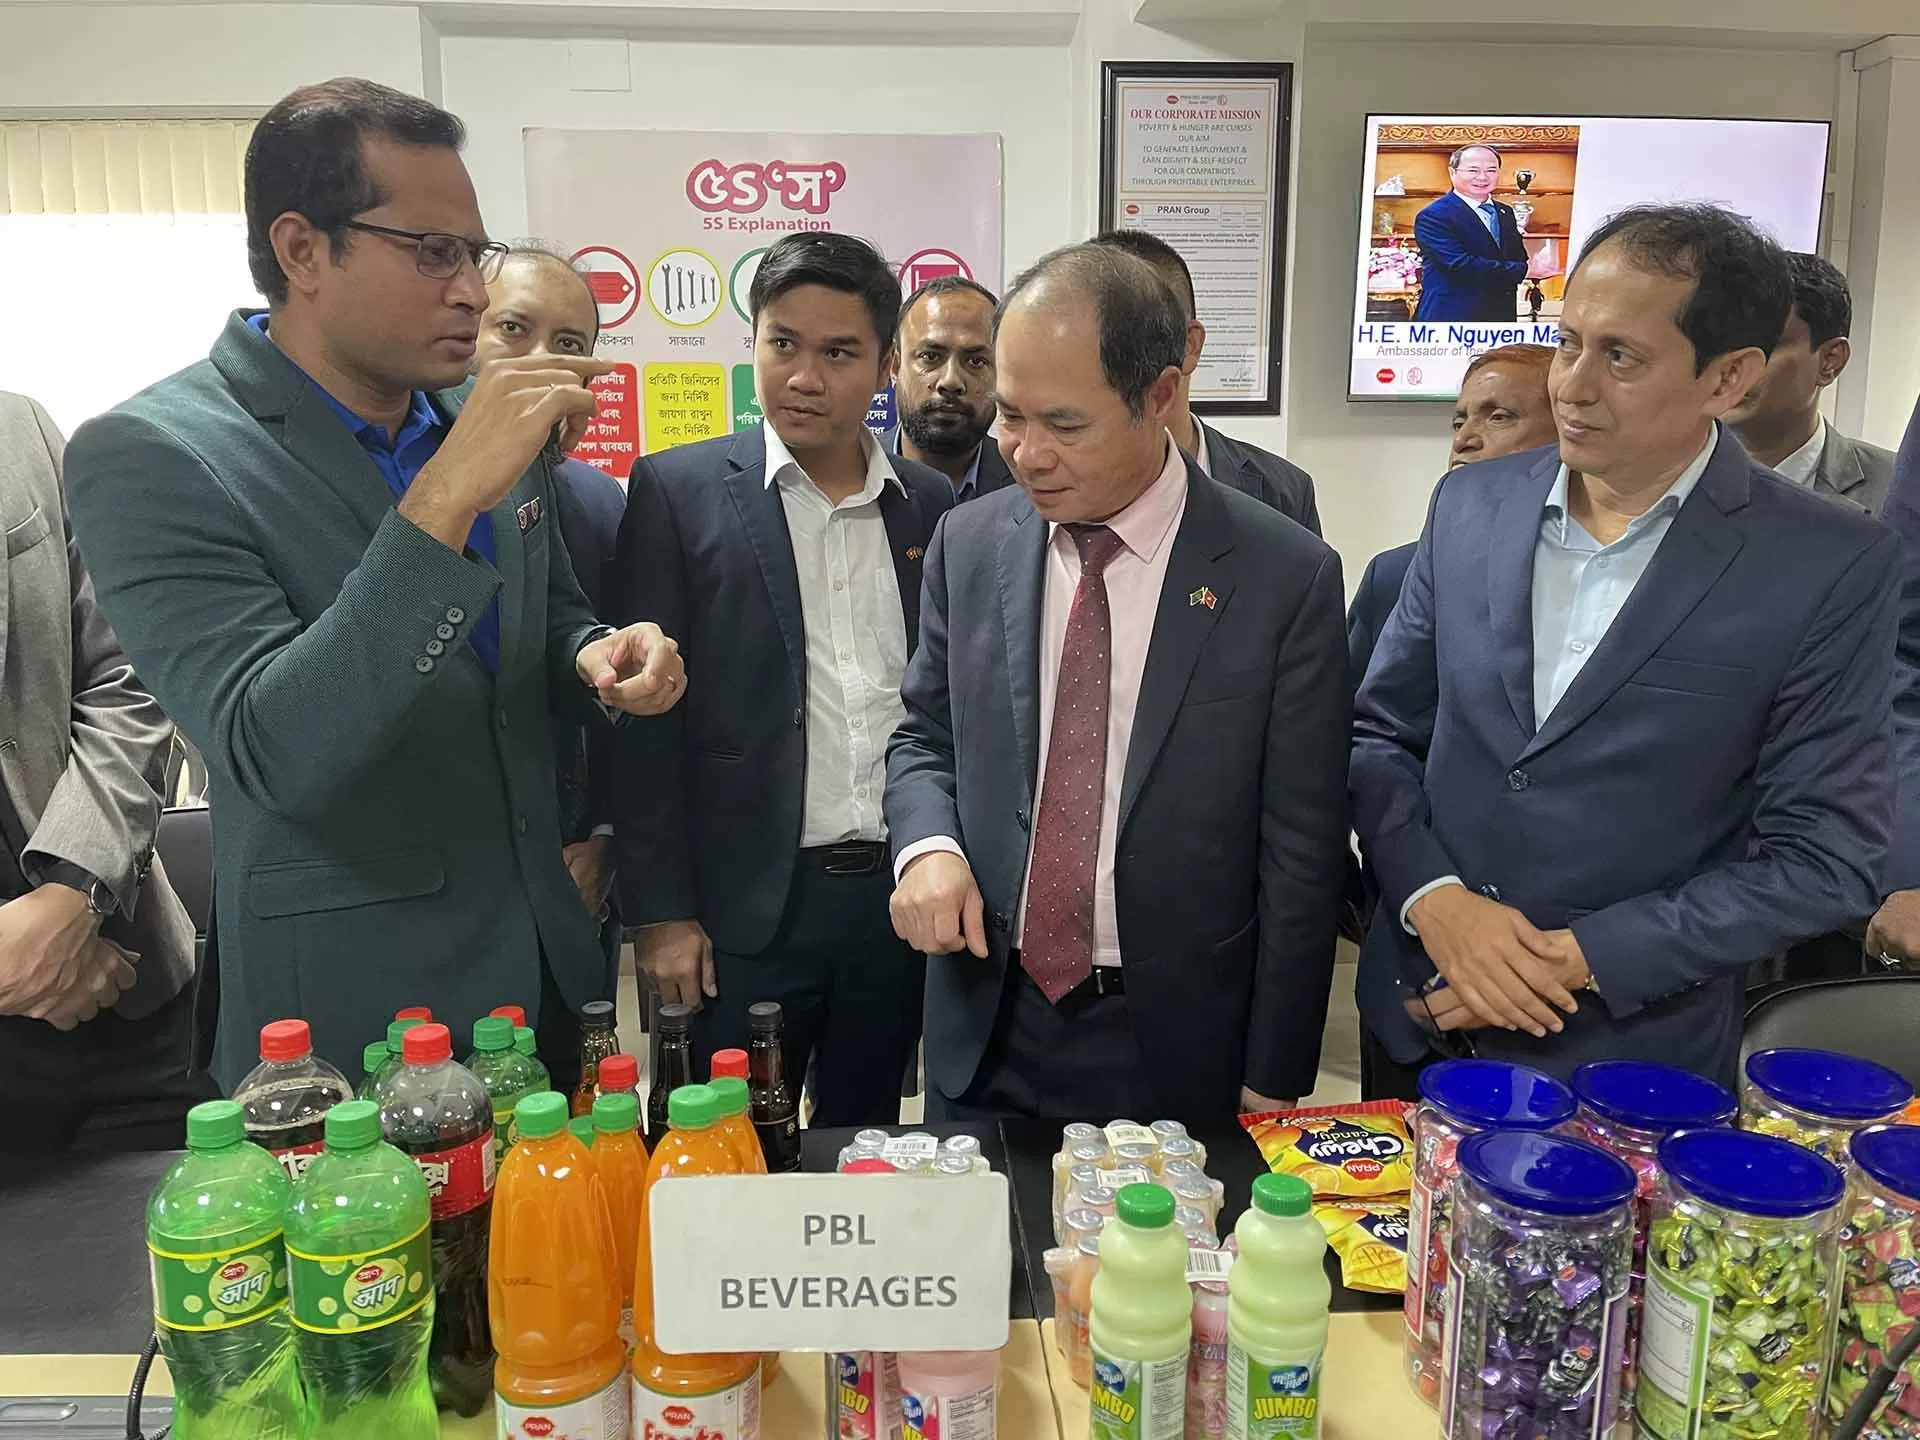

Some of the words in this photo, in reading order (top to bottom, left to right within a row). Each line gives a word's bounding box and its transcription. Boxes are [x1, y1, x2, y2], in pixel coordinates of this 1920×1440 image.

[1130, 109, 1152, 120] OUR
[1155, 109, 1216, 120] CORPORATE
[1220, 110, 1262, 121] MISSION
[1139, 124, 1169, 132] POVERTY
[1179, 124, 1210, 132] HUNGER
[1211, 124, 1224, 132] ARE
[1143, 146, 1152, 154] TO
[1154, 146, 1189, 154] GENERATE
[1191, 146, 1240, 154] EMPLOYMENT
[1142, 157, 1160, 165] EARN
[1162, 157, 1191, 165] DIGNITY
[1218, 157, 1248, 165] RESPECT
[1154, 168, 1168, 176] FOR
[1169, 168, 1186, 176] OUR
[1132, 178, 1167, 186] THROUGH
[1168, 178, 1208, 186] PROFITABLE
[1157, 206, 1182, 215] PRAN
[1183, 206, 1211, 217] Group
[728, 216, 832, 233] Explanation
[1358, 325, 1401, 344] H.E.
[1408, 325, 1440, 344] Mr.
[1448, 325, 1525, 348] Nguyen
[1533, 325, 1561, 344] Ma
[1376, 345, 1449, 356] Ambassador
[1451, 345, 1463, 356] of
[1319, 1129, 1369, 1140] candy
[1307, 1136, 1402, 1158] Chewy
[1346, 1163, 1381, 1173] PRAN
[803, 1213, 877, 1247] PBL
[719, 1275, 959, 1311] BEVERAGES
[1254, 1397, 1317, 1420] JUMBO
[665, 1410, 691, 1421] PRAN
